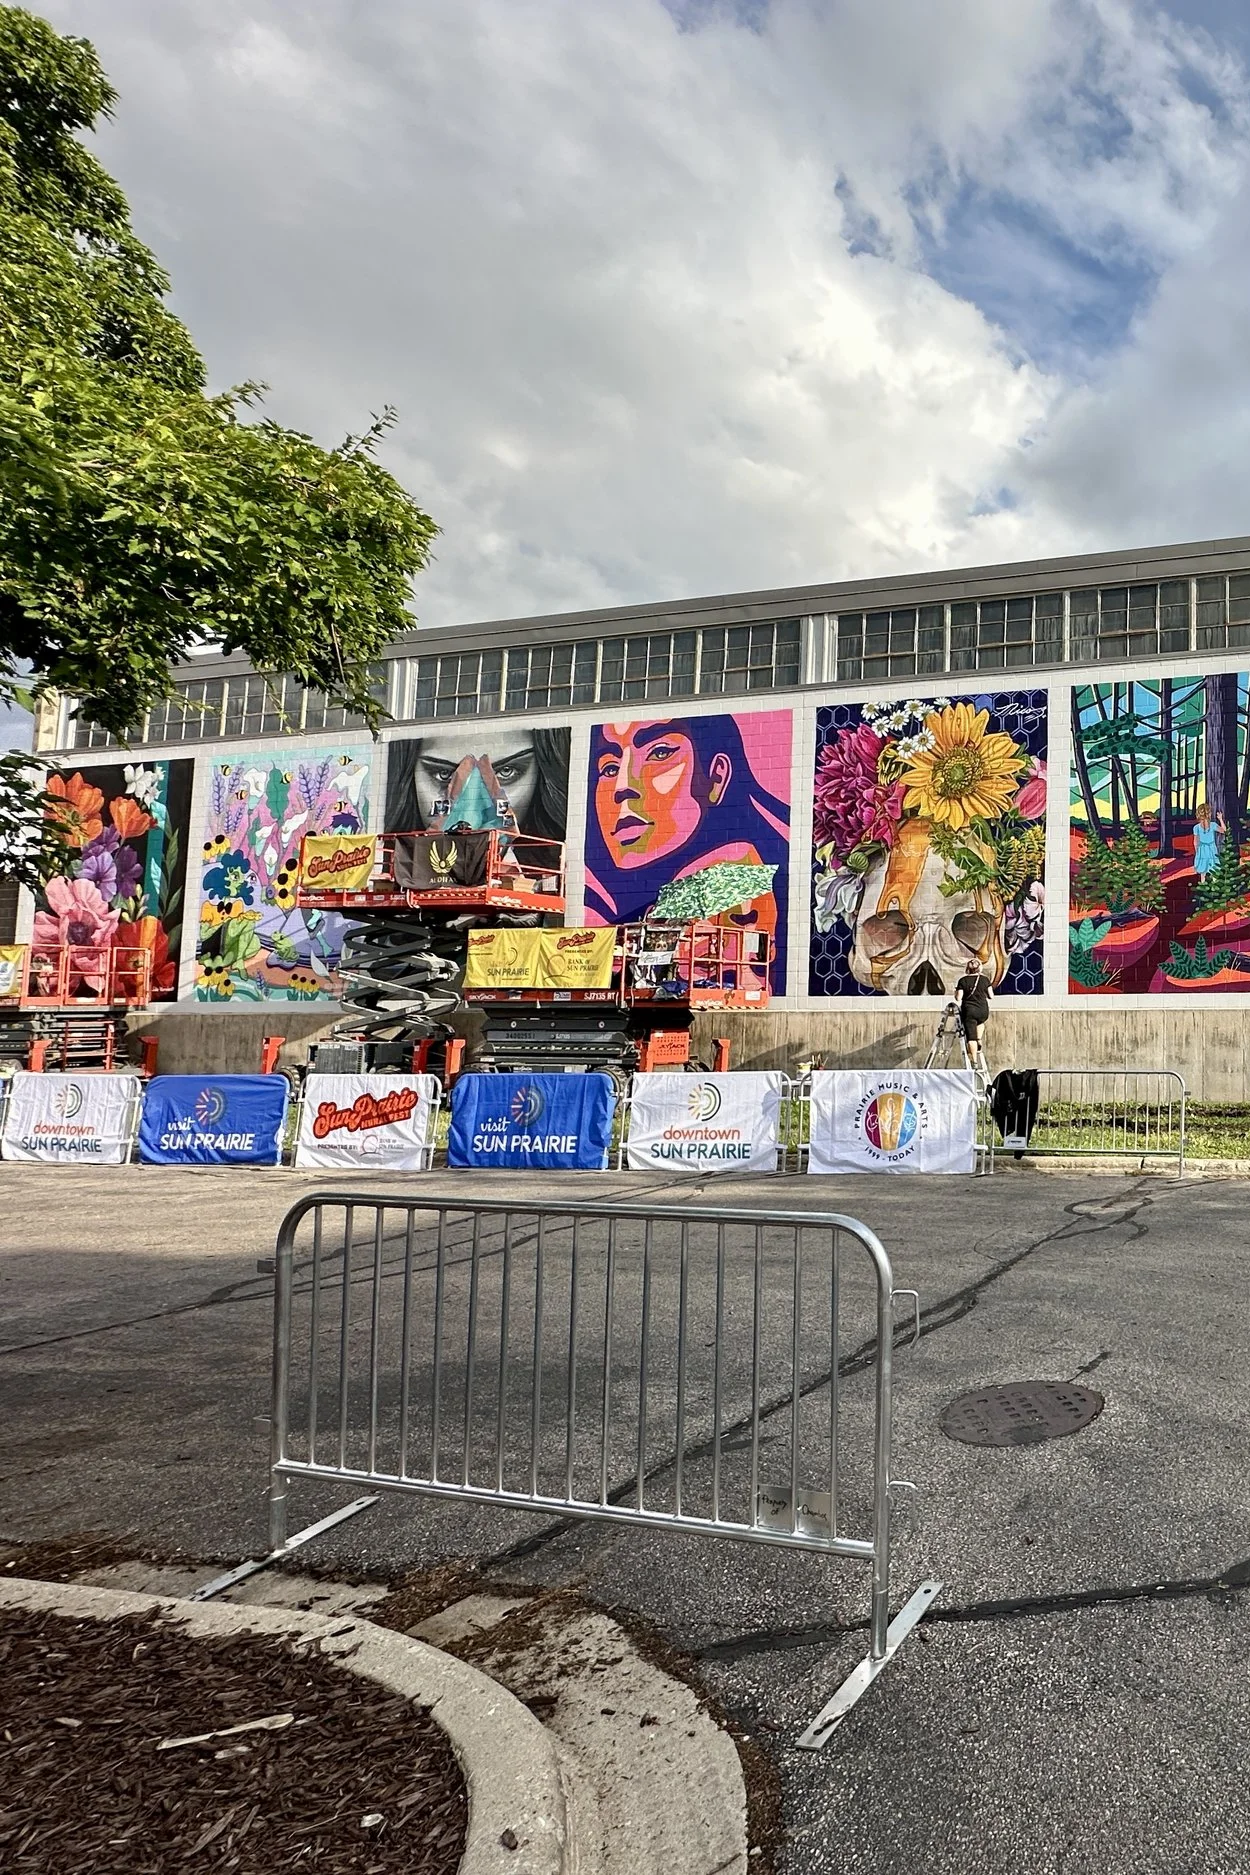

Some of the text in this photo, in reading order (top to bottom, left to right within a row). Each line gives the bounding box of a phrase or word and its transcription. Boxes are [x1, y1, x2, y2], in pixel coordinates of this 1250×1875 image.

[487, 967, 530, 977] SUN PRAIRIE
[313, 1087, 419, 1139] Sun Prairie
[854, 1089, 875, 1129] PRAIRIE
[878, 1082, 910, 1093] MUSIC
[918, 1102, 929, 1129] ARTS
[33, 1121, 95, 1136] downtown
[167, 1116, 196, 1131] visit
[480, 1116, 511, 1132] visit
[663, 1124, 741, 1140] downtown
[21, 1136, 102, 1153] SUN PRAIRIE
[160, 1133, 256, 1150] SUN PRAIRIE
[473, 1134, 578, 1154] SUN PRAIRIE
[650, 1143, 752, 1160] SUN PRAIRIE
[864, 1146, 880, 1160] 1999
[887, 1145, 915, 1162] TODAY
